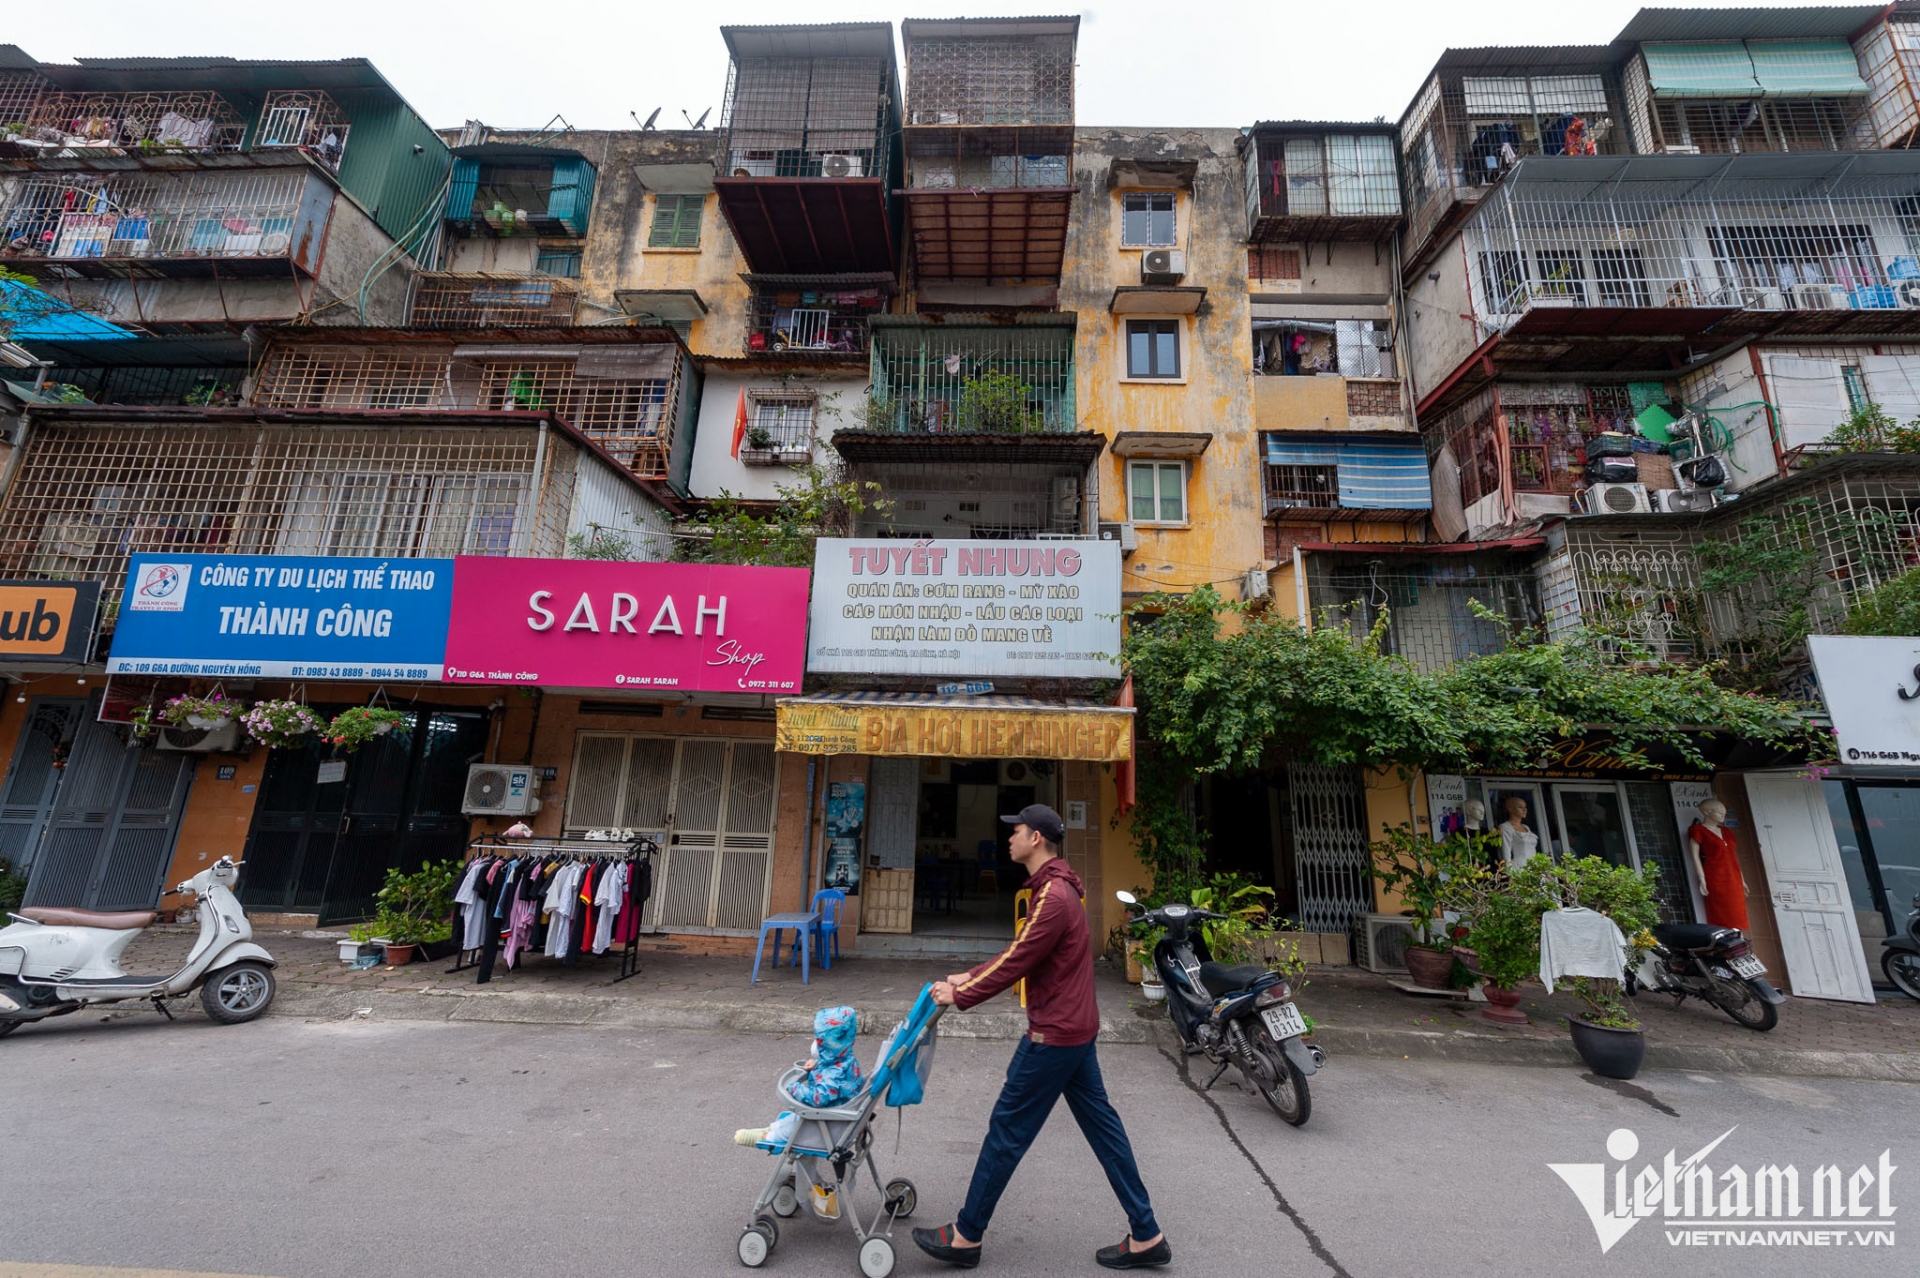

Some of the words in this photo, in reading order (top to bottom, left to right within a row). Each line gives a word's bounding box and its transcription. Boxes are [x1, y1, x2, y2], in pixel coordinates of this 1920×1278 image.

[849, 540, 947, 576] TUYẾT
[957, 547, 1082, 577] NHUNG
[200, 563, 249, 587] CÔNG
[254, 567, 275, 588] TY
[278, 568, 303, 588] DU
[306, 568, 348, 593] LỊCH
[352, 562, 388, 589] THỂ
[390, 570, 435, 590] THAO
[847, 582, 889, 598] QUÁN
[923, 582, 958, 598] CƠM
[963, 585, 1005, 599] RANG
[1047, 584, 1079, 600] XÀO
[218, 601, 309, 636] THÀNH
[315, 603, 393, 638] CÔNG
[527, 590, 727, 636] SARAH
[843, 604, 875, 619] CÁC
[879, 604, 914, 619] MÓN
[918, 604, 961, 622] NHẬU
[1010, 606, 1042, 621] CÁC
[1047, 607, 1083, 624] LOẠI
[872, 625, 914, 643] NHẬN
[919, 626, 950, 641] LÀM
[981, 628, 1028, 642] MANG
[1033, 625, 1052, 642] VỀ
[706, 639, 765, 676] Shop
[118, 662, 132, 672] ĐC:
[135, 663, 150, 673] 109
[151, 663, 168, 673] G6A
[170, 662, 199, 674] ĐƯỜNG
[201, 663, 235, 675] NGUYÊN
[306, 667, 327, 677] 0983
[329, 668, 340, 677] 43
[342, 667, 363, 677] 8889
[371, 668, 391, 678] 0944
[406, 669, 428, 679] 8889
[469, 671, 485, 679] G6A
[488, 670, 512, 679] THÀNH
[515, 671, 538, 680] CÔNG
[626, 676, 651, 685] SARAH
[653, 677, 678, 685] SARAH
[748, 680, 765, 688] 0972
[866, 716, 908, 752] BIA
[971, 718, 1120, 758] HENNINGER
[798, 743, 820, 752] 0977
[823, 744, 839, 753] 925
[841, 744, 857, 753] 285
[1273, 1019, 1301, 1037] 0314
